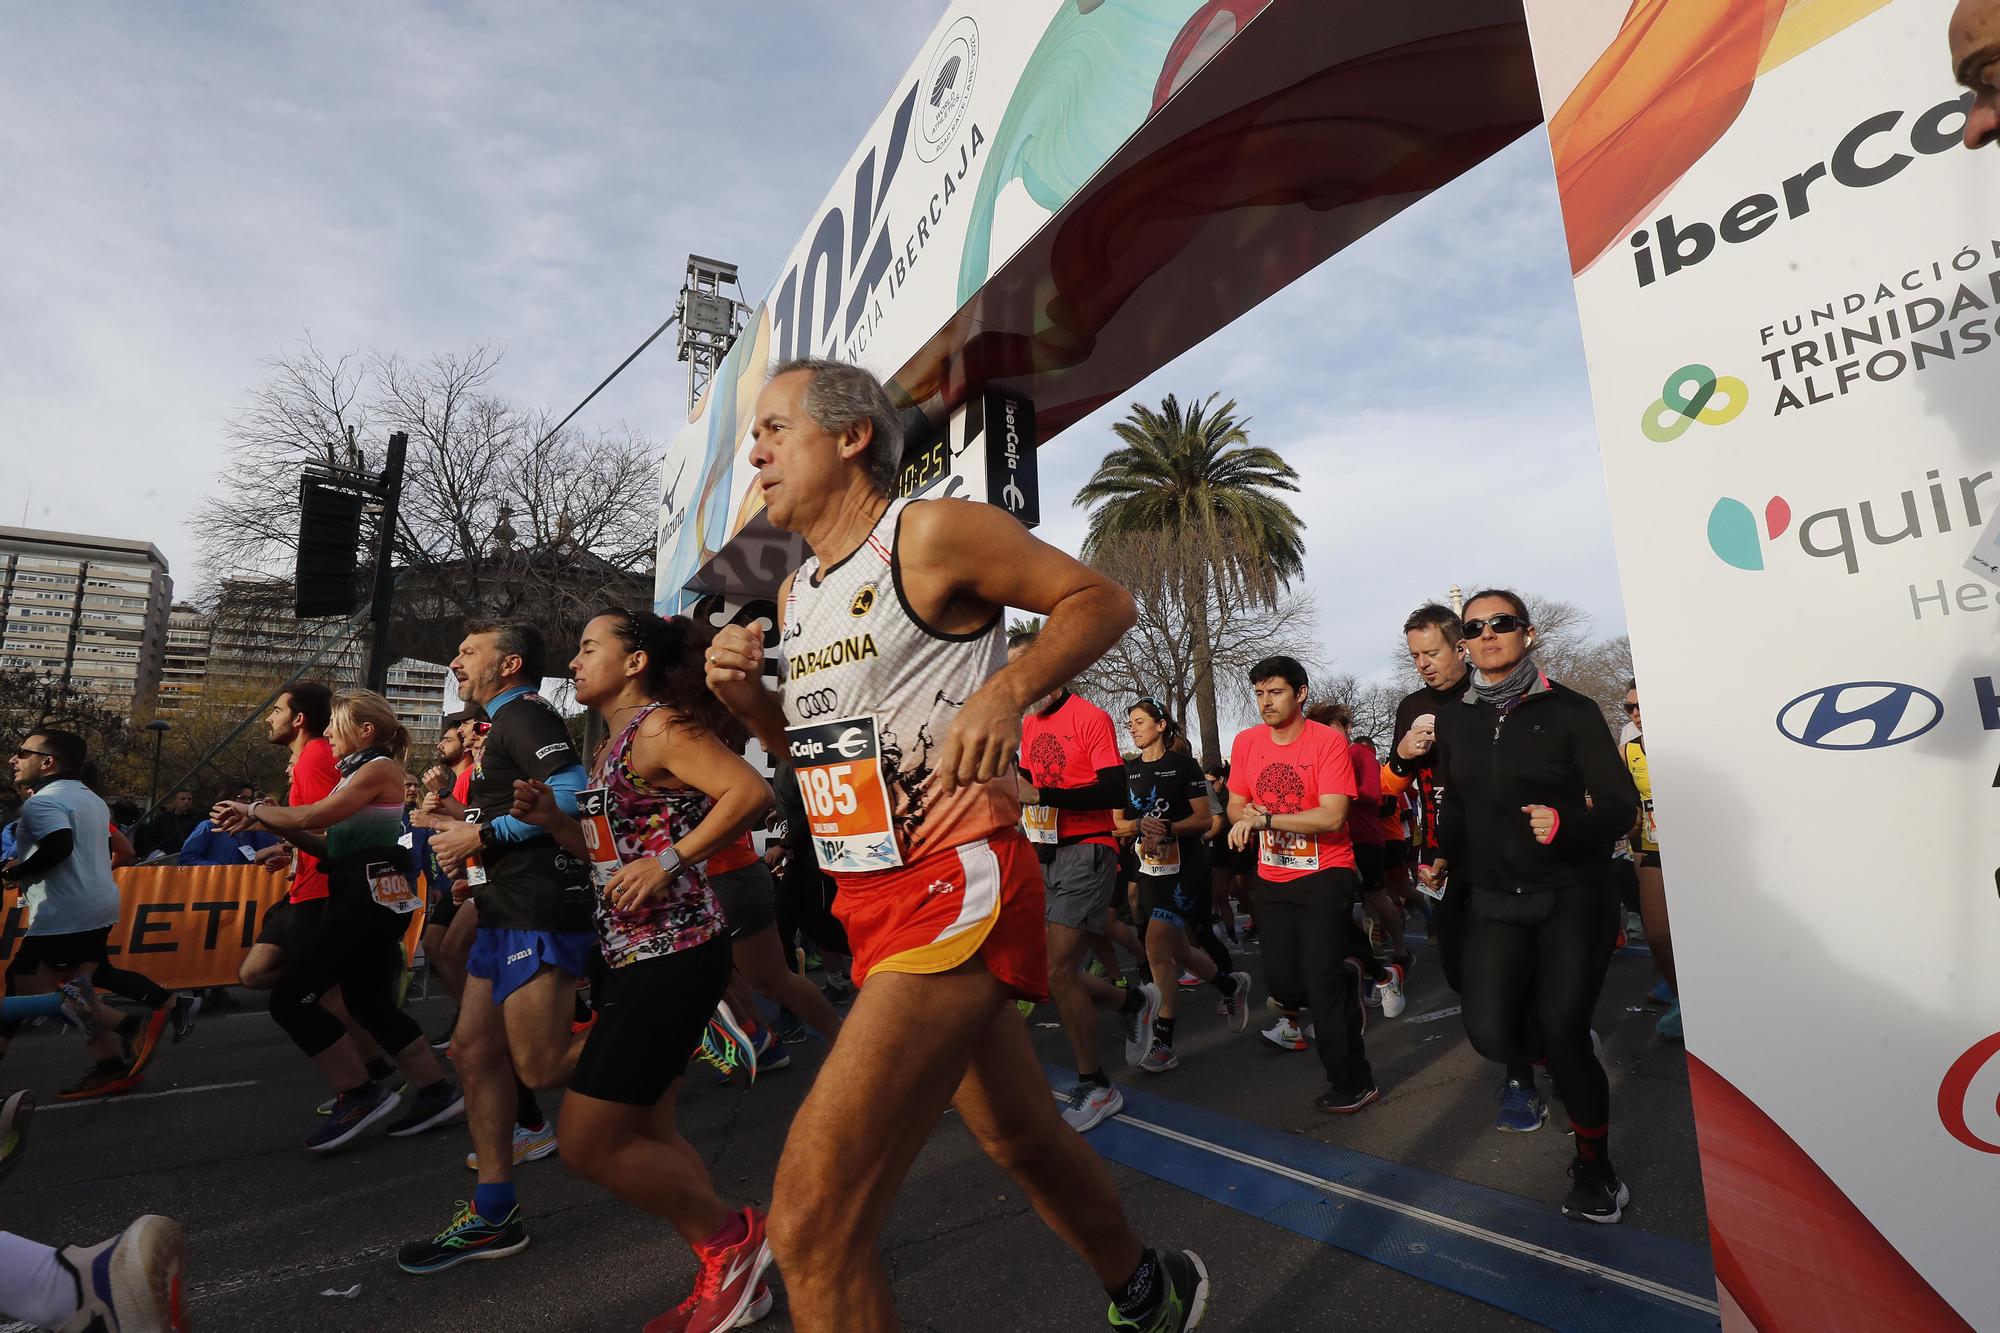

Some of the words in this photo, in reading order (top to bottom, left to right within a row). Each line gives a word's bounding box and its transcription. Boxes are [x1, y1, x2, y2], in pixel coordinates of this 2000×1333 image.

[843, 299, 884, 365] NCIA
[888, 122, 985, 300] IBERCAJA
[1774, 317, 2000, 416] ALFONS
[1004, 399, 1020, 469] iberCaja
[1908, 579, 2000, 620] He
[790, 633, 878, 680] TARAZONA
[797, 765, 857, 817] 185
[1152, 909, 1174, 922] EAM
